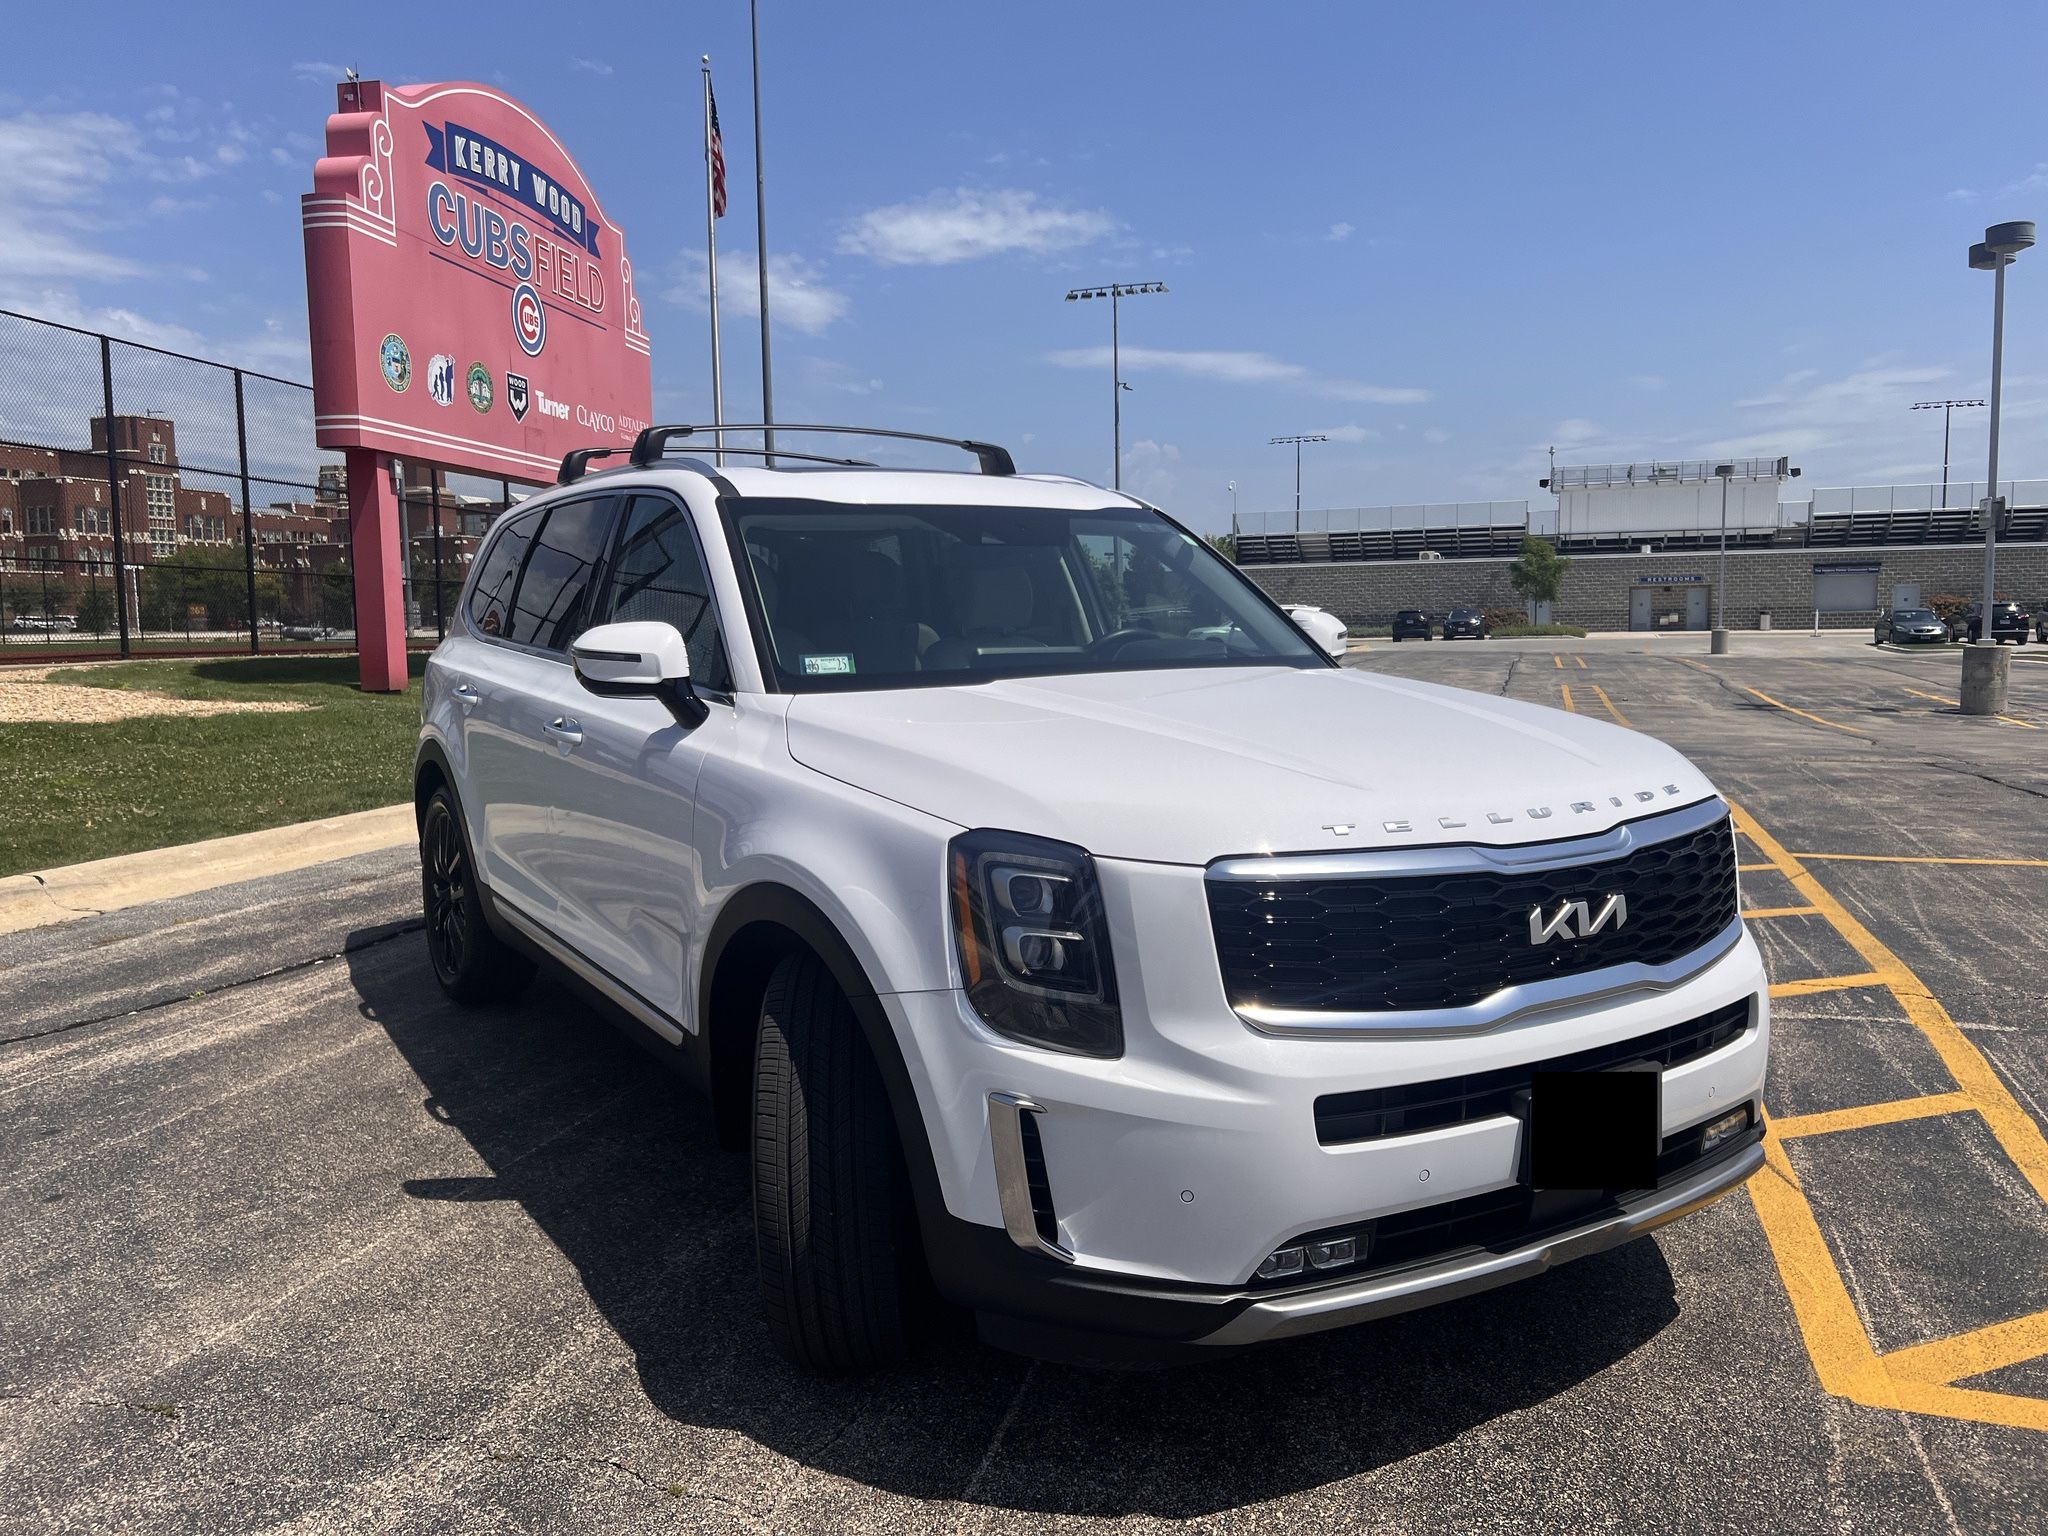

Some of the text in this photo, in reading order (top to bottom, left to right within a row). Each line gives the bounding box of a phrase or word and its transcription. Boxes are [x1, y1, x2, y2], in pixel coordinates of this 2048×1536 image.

[454, 135, 581, 234] KERRY WOOD
[428, 181, 606, 313] CUBS FIELD
[508, 376, 526, 389] WOOD
[510, 389, 526, 412] W
[535, 389, 570, 420] Turner
[576, 404, 615, 433] CLAYCO
[1321, 783, 1681, 837] TELLURIDE
